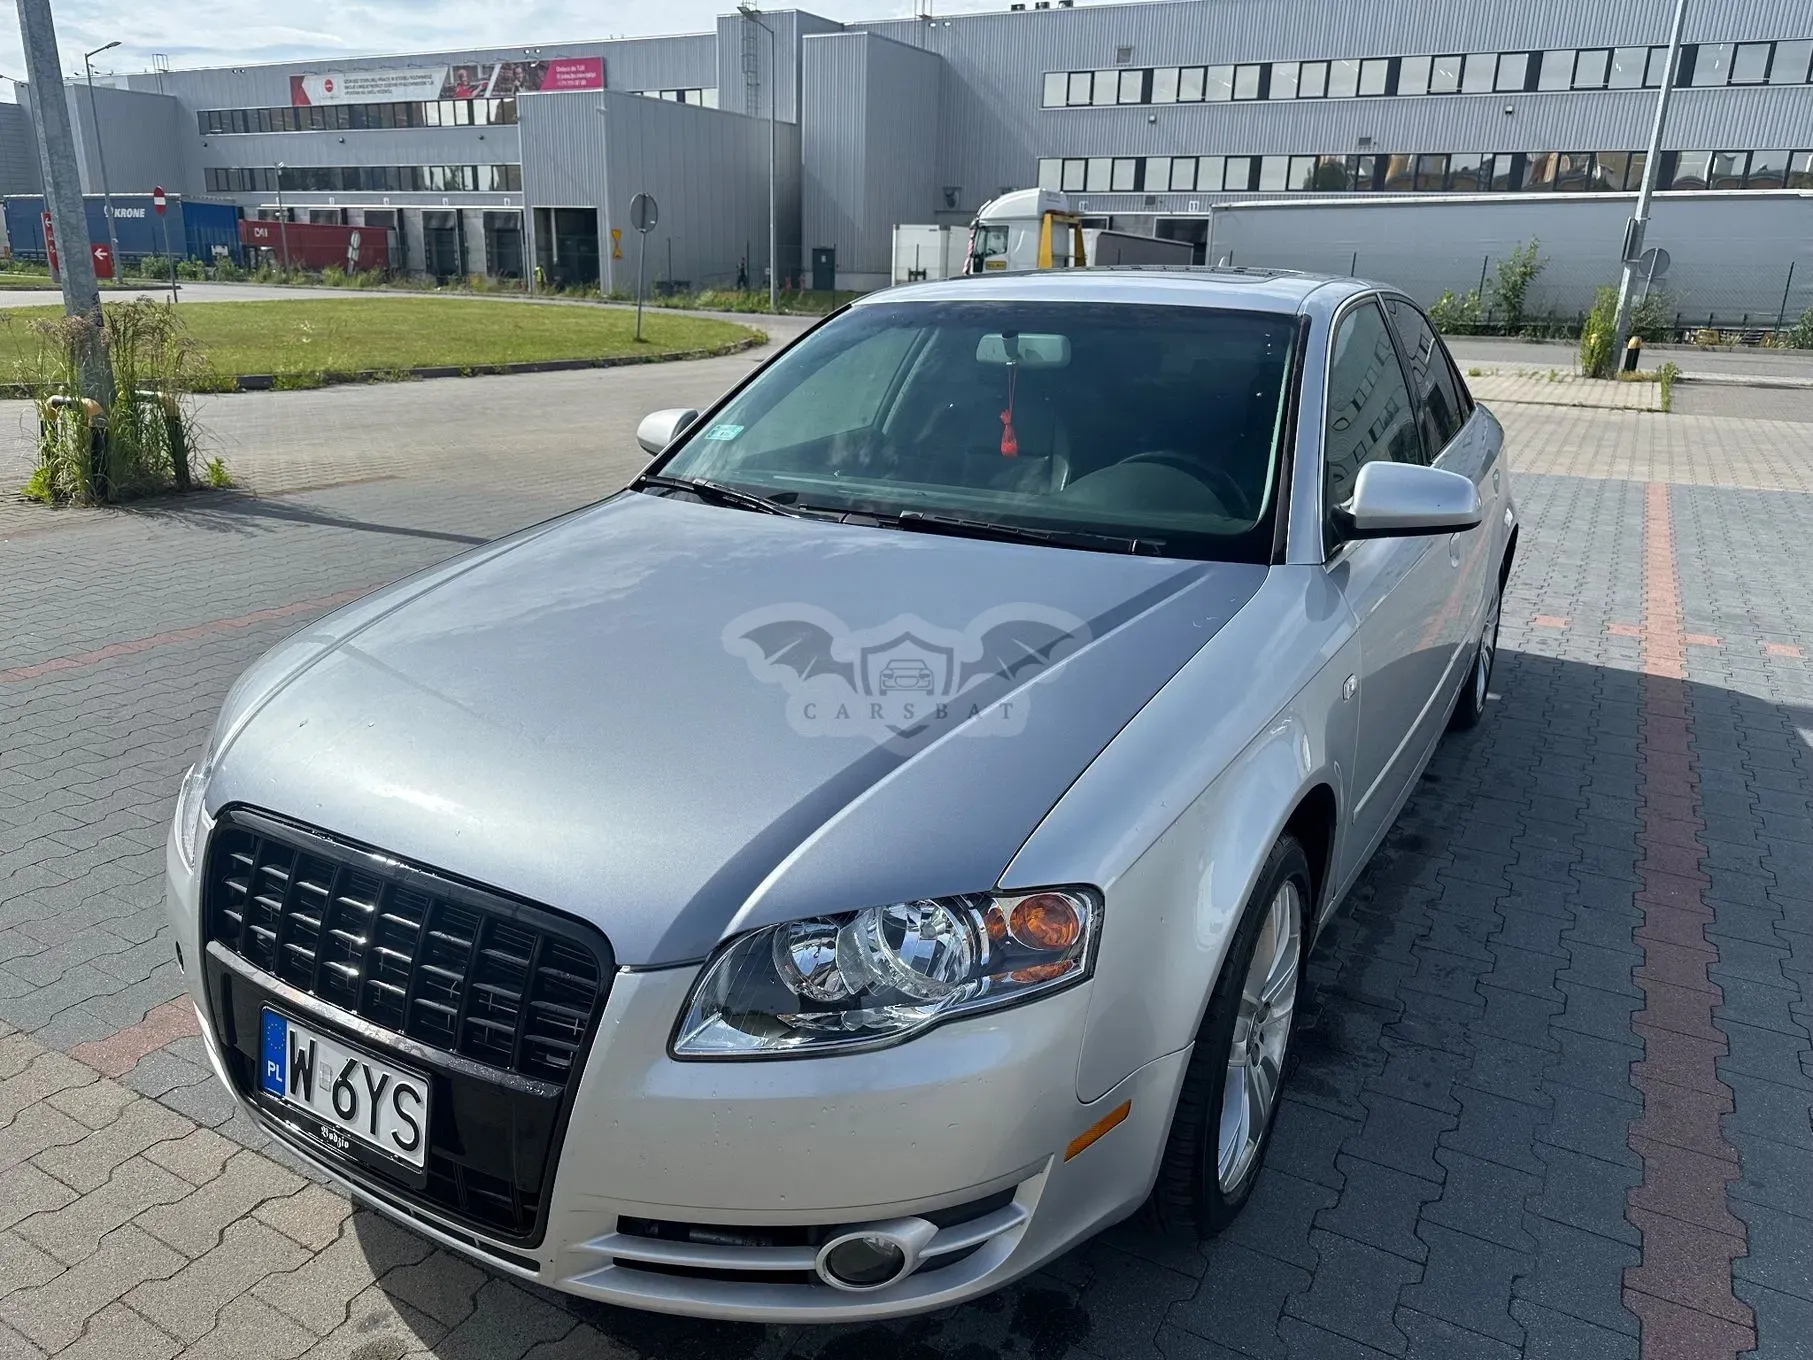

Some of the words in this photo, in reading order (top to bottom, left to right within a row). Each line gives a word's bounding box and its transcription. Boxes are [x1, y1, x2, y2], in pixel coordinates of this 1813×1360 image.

[114, 208, 145, 218] KRONE
[267, 1059, 283, 1082] PL
[289, 1029, 317, 1103] W
[331, 1056, 423, 1152] 6YS
